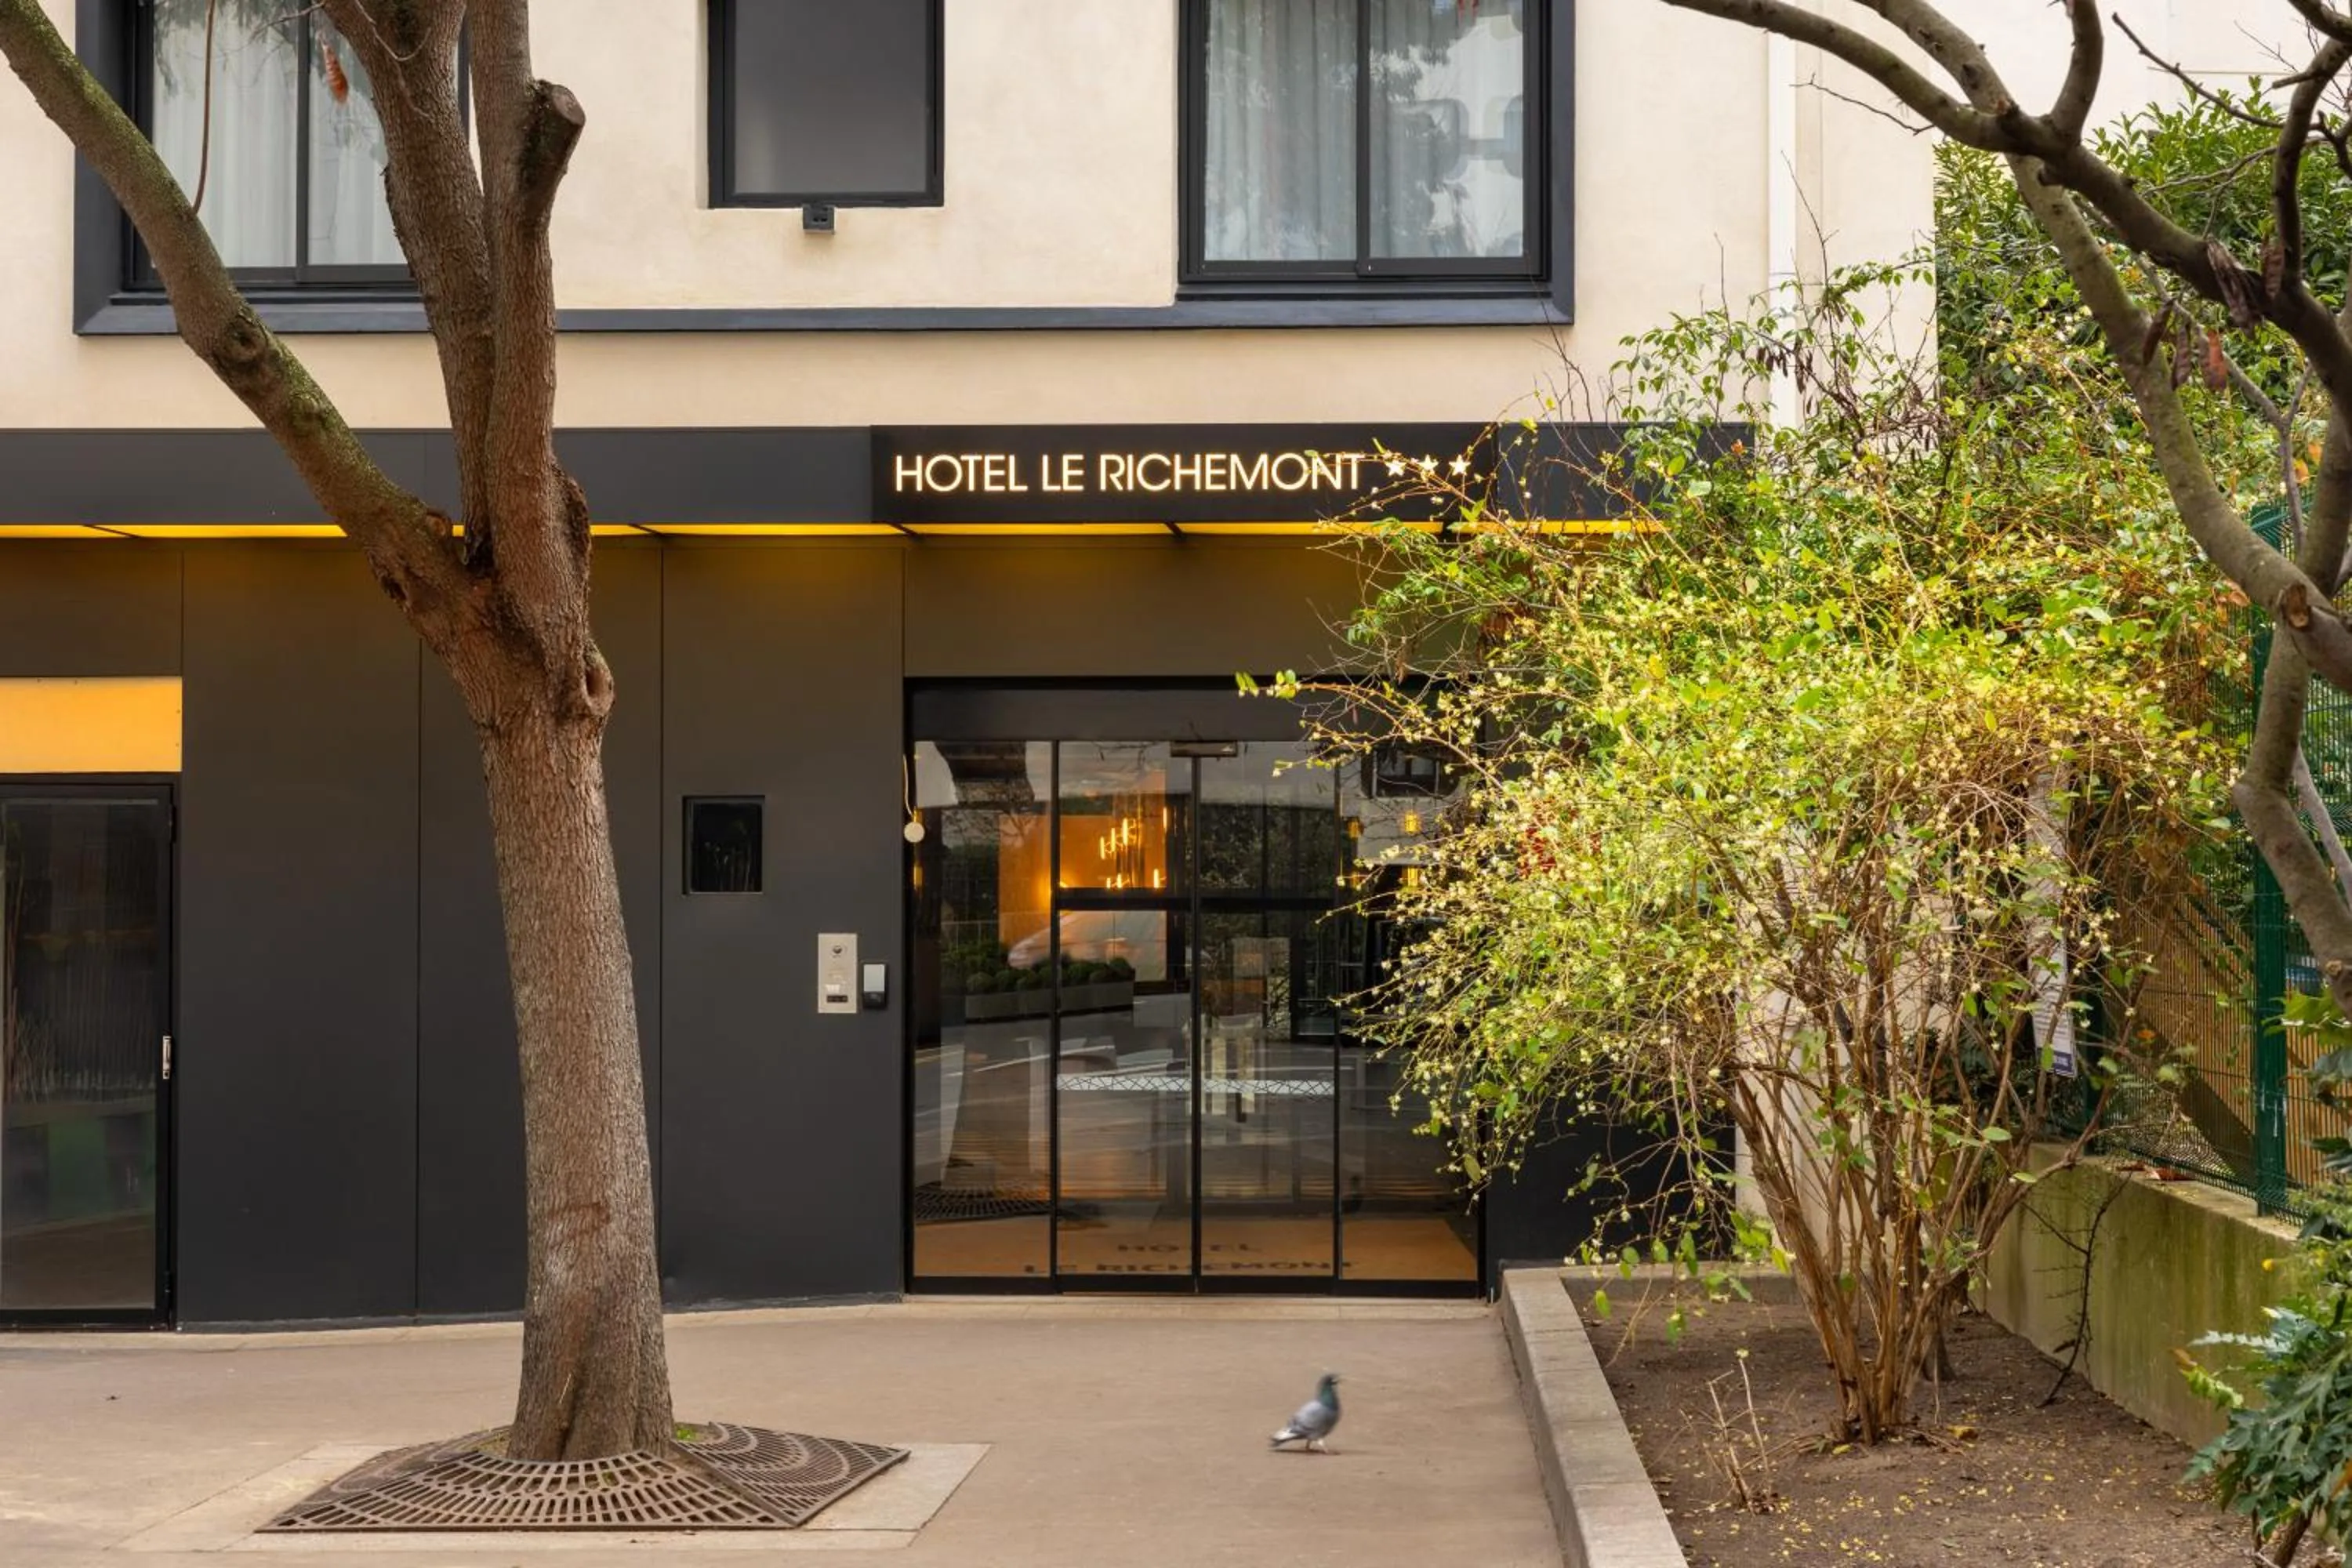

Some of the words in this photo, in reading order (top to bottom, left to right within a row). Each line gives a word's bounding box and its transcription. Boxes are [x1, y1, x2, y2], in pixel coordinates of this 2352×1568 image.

[895, 454, 1029, 492] HOTEL
[1041, 454, 1085, 492] LE
[1098, 452, 1365, 491] RICHEMONT
[1117, 1243, 1262, 1253] HOEL
